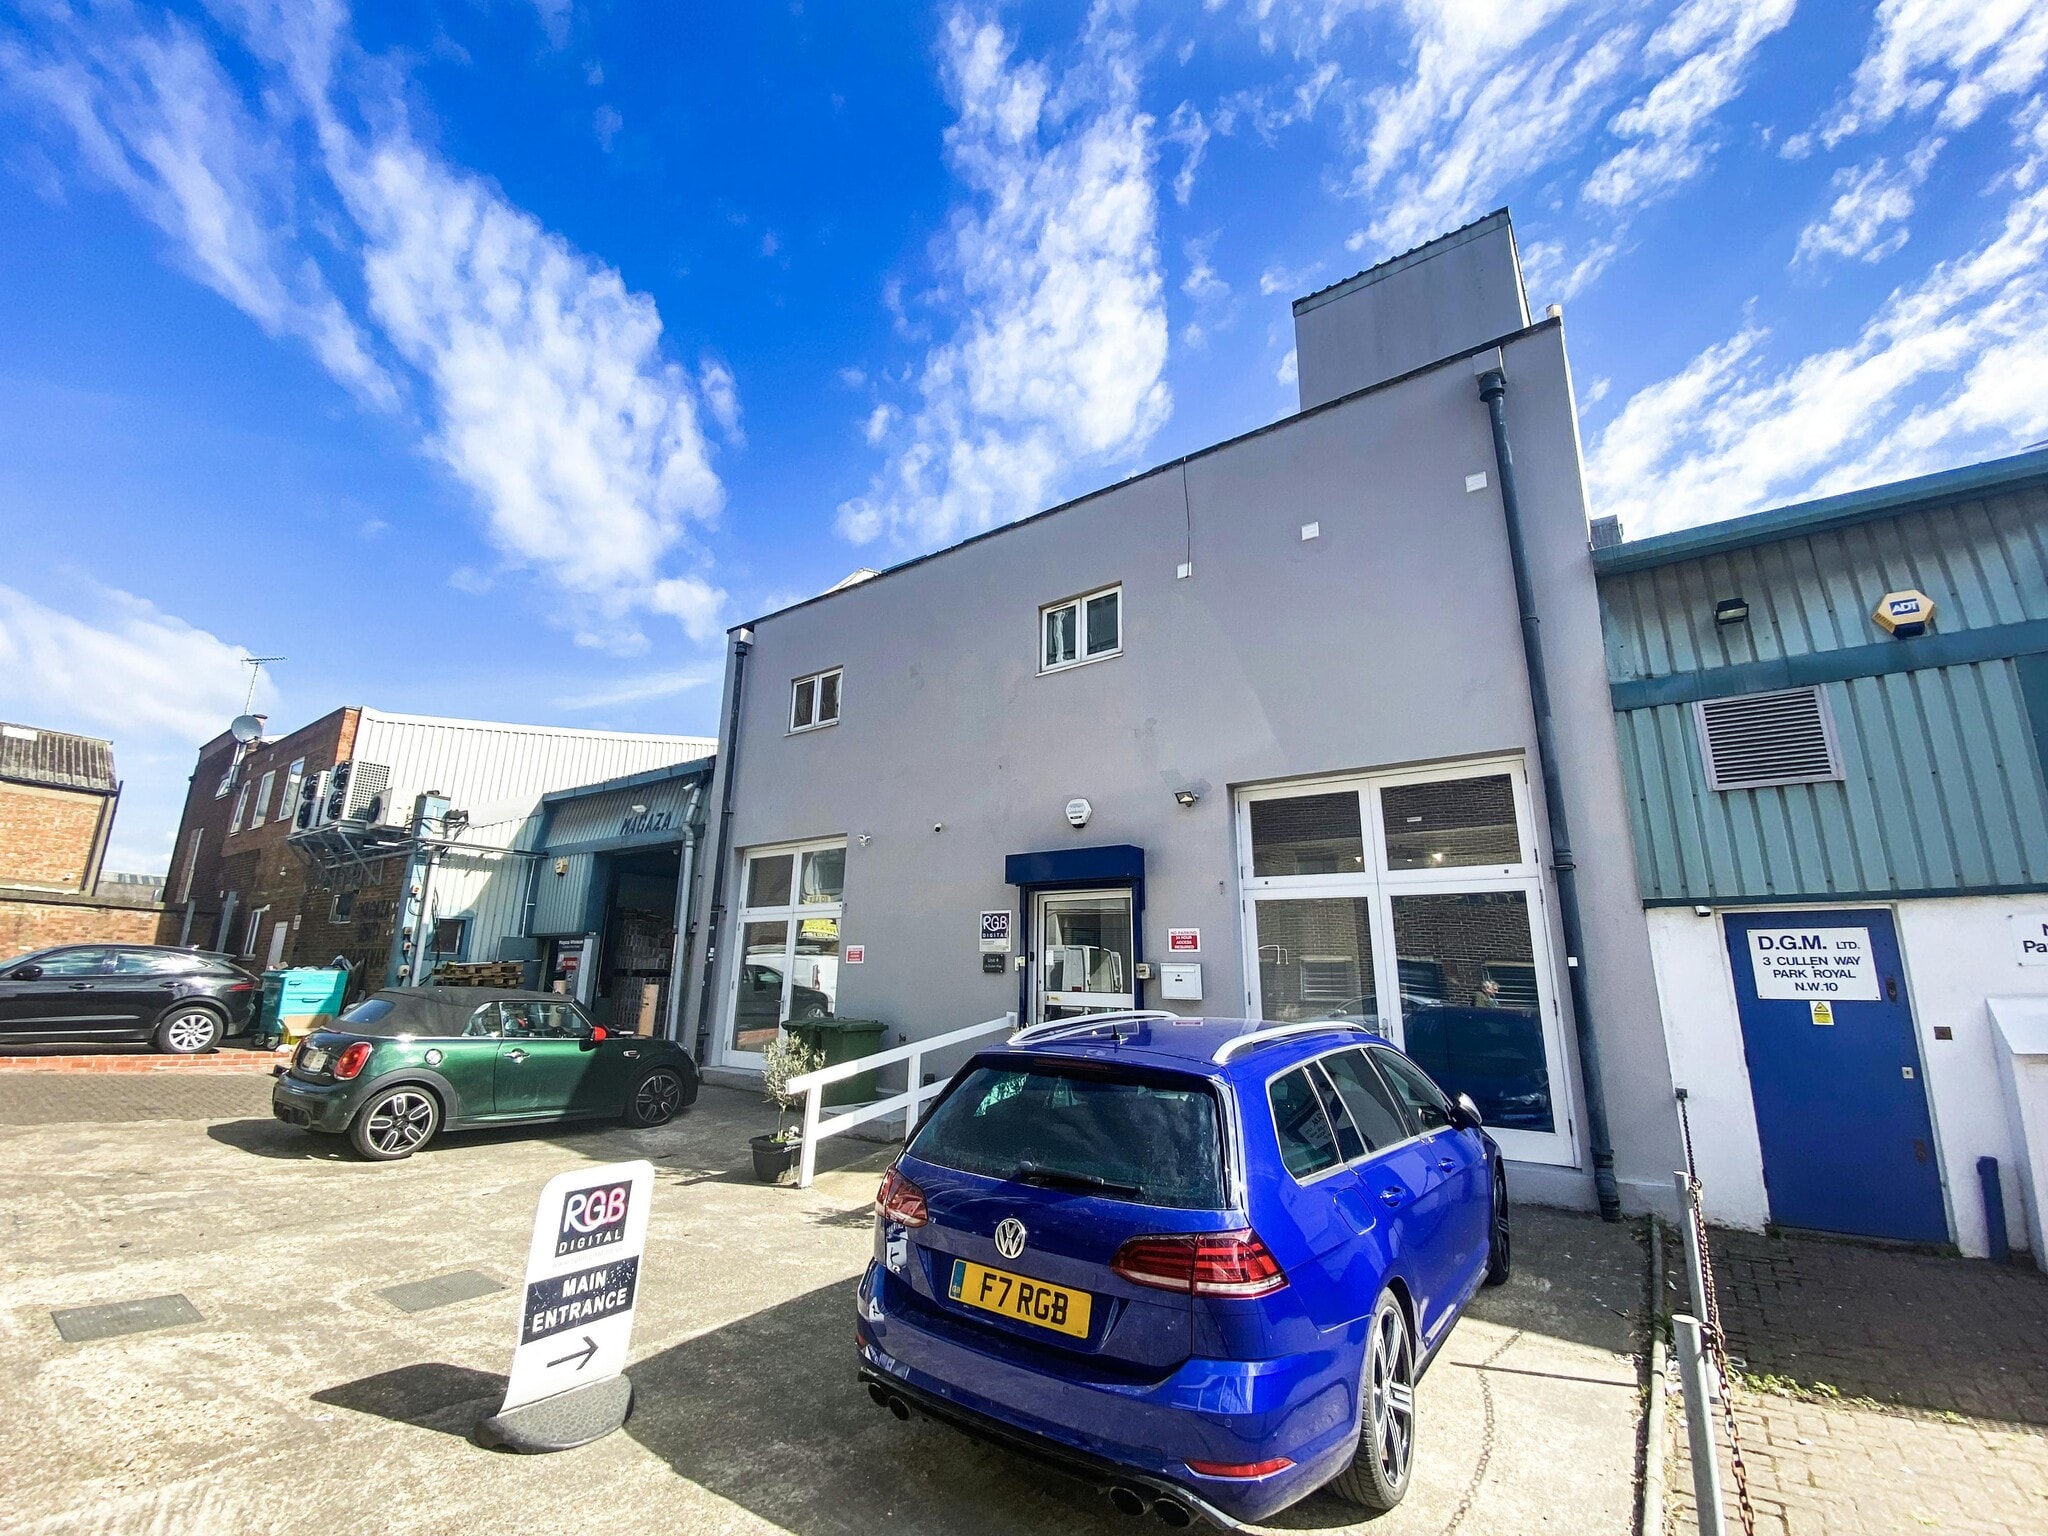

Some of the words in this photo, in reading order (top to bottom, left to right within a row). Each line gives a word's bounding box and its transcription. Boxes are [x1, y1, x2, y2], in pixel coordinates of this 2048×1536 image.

[1892, 601, 1917, 613] ADT
[619, 811, 672, 836] MAGAZA
[983, 915, 1007, 931] RGB
[1757, 935, 1827, 950] D.G.M.
[1836, 941, 1861, 950] LTD.
[2022, 940, 2048, 953] Pa
[1762, 956, 1771, 966] 3
[1776, 956, 1829, 966] CULLEN
[1833, 956, 1861, 966] WAY
[1773, 969, 1808, 979] PARK
[1813, 969, 1856, 979] ROYAL
[1794, 982, 1839, 992] N.W.10
[563, 1187, 626, 1233] RGB
[558, 1229, 621, 1254] DIGITAL
[562, 1270, 607, 1298] MAIN
[979, 1272, 1013, 1307] F7
[1016, 1282, 1069, 1326] RGB
[532, 1287, 628, 1333] ENTRANCE
